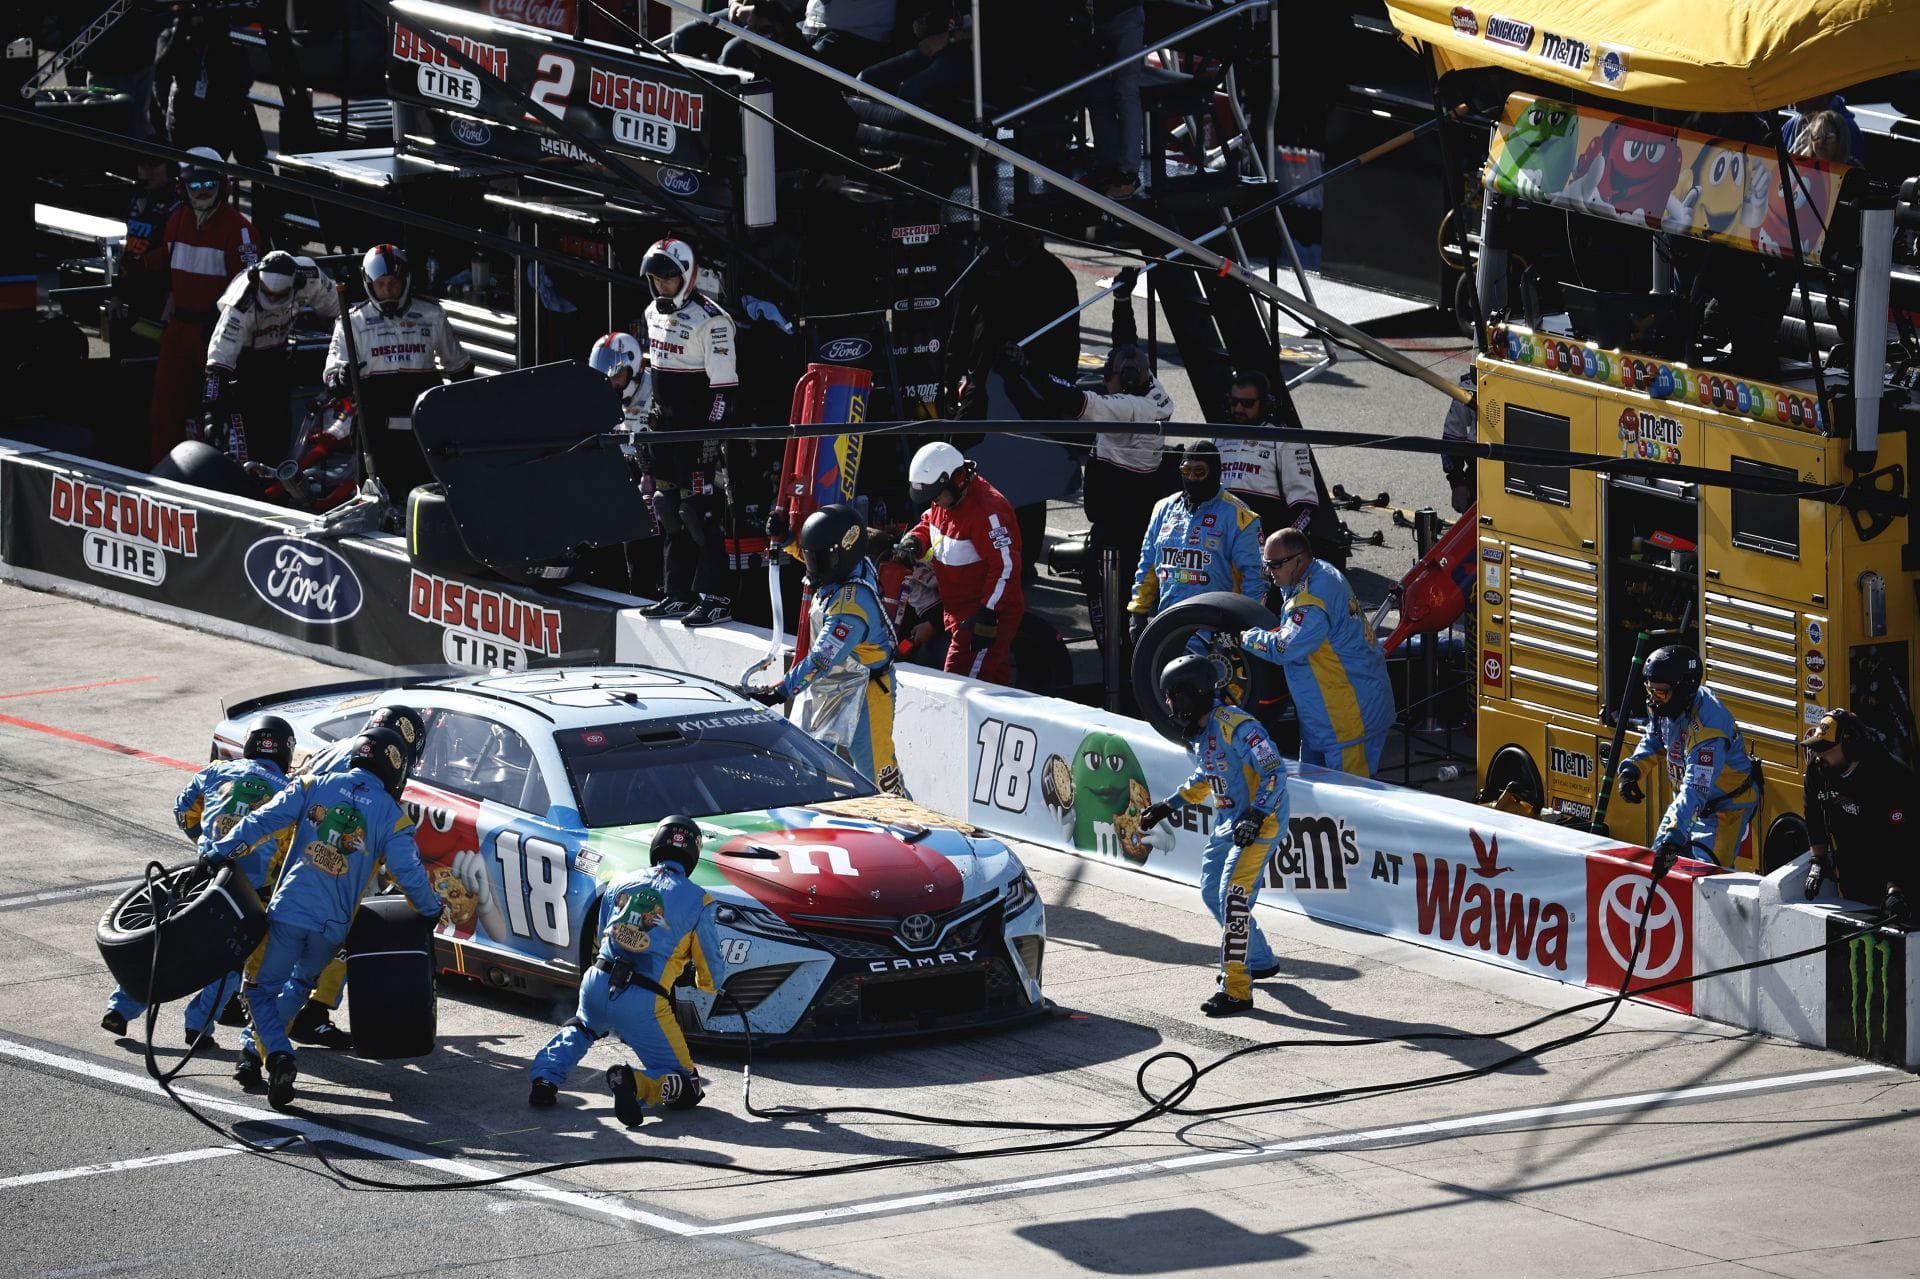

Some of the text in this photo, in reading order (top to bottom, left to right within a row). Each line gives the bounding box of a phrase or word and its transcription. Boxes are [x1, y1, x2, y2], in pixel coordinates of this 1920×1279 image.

[1487, 17, 1529, 45] SNICKERS
[425, 71, 474, 101] TIRE
[523, 52, 576, 123] 2
[589, 66, 703, 131] DISCOUNT
[457, 118, 484, 142] Ford
[619, 116, 669, 148] TIRE
[541, 137, 604, 167] MENAR
[662, 169, 692, 193] Ford
[892, 224, 940, 239] DISCOUNT
[905, 235, 926, 243] TIRE
[896, 265, 937, 275] MEARDS
[828, 341, 862, 358] Ford
[51, 473, 199, 558] DISCOUNT
[93, 537, 157, 577] TIRE
[267, 544, 342, 613] Ford
[409, 568, 562, 658] DISCOUNT
[452, 634, 518, 671] TIRE
[678, 718, 725, 732] KYLE
[973, 717, 1038, 814] 18
[1561, 800, 1592, 819] NASCAR
[314, 844, 344, 866] CRUNCHY
[314, 853, 338, 873] COOKIE
[495, 830, 570, 948] 18
[1168, 804, 1213, 836] GET
[1371, 851, 1404, 886] AT
[1413, 852, 1569, 971] Wawa
[720, 937, 752, 965] 18
[869, 950, 979, 972] CAMRY
